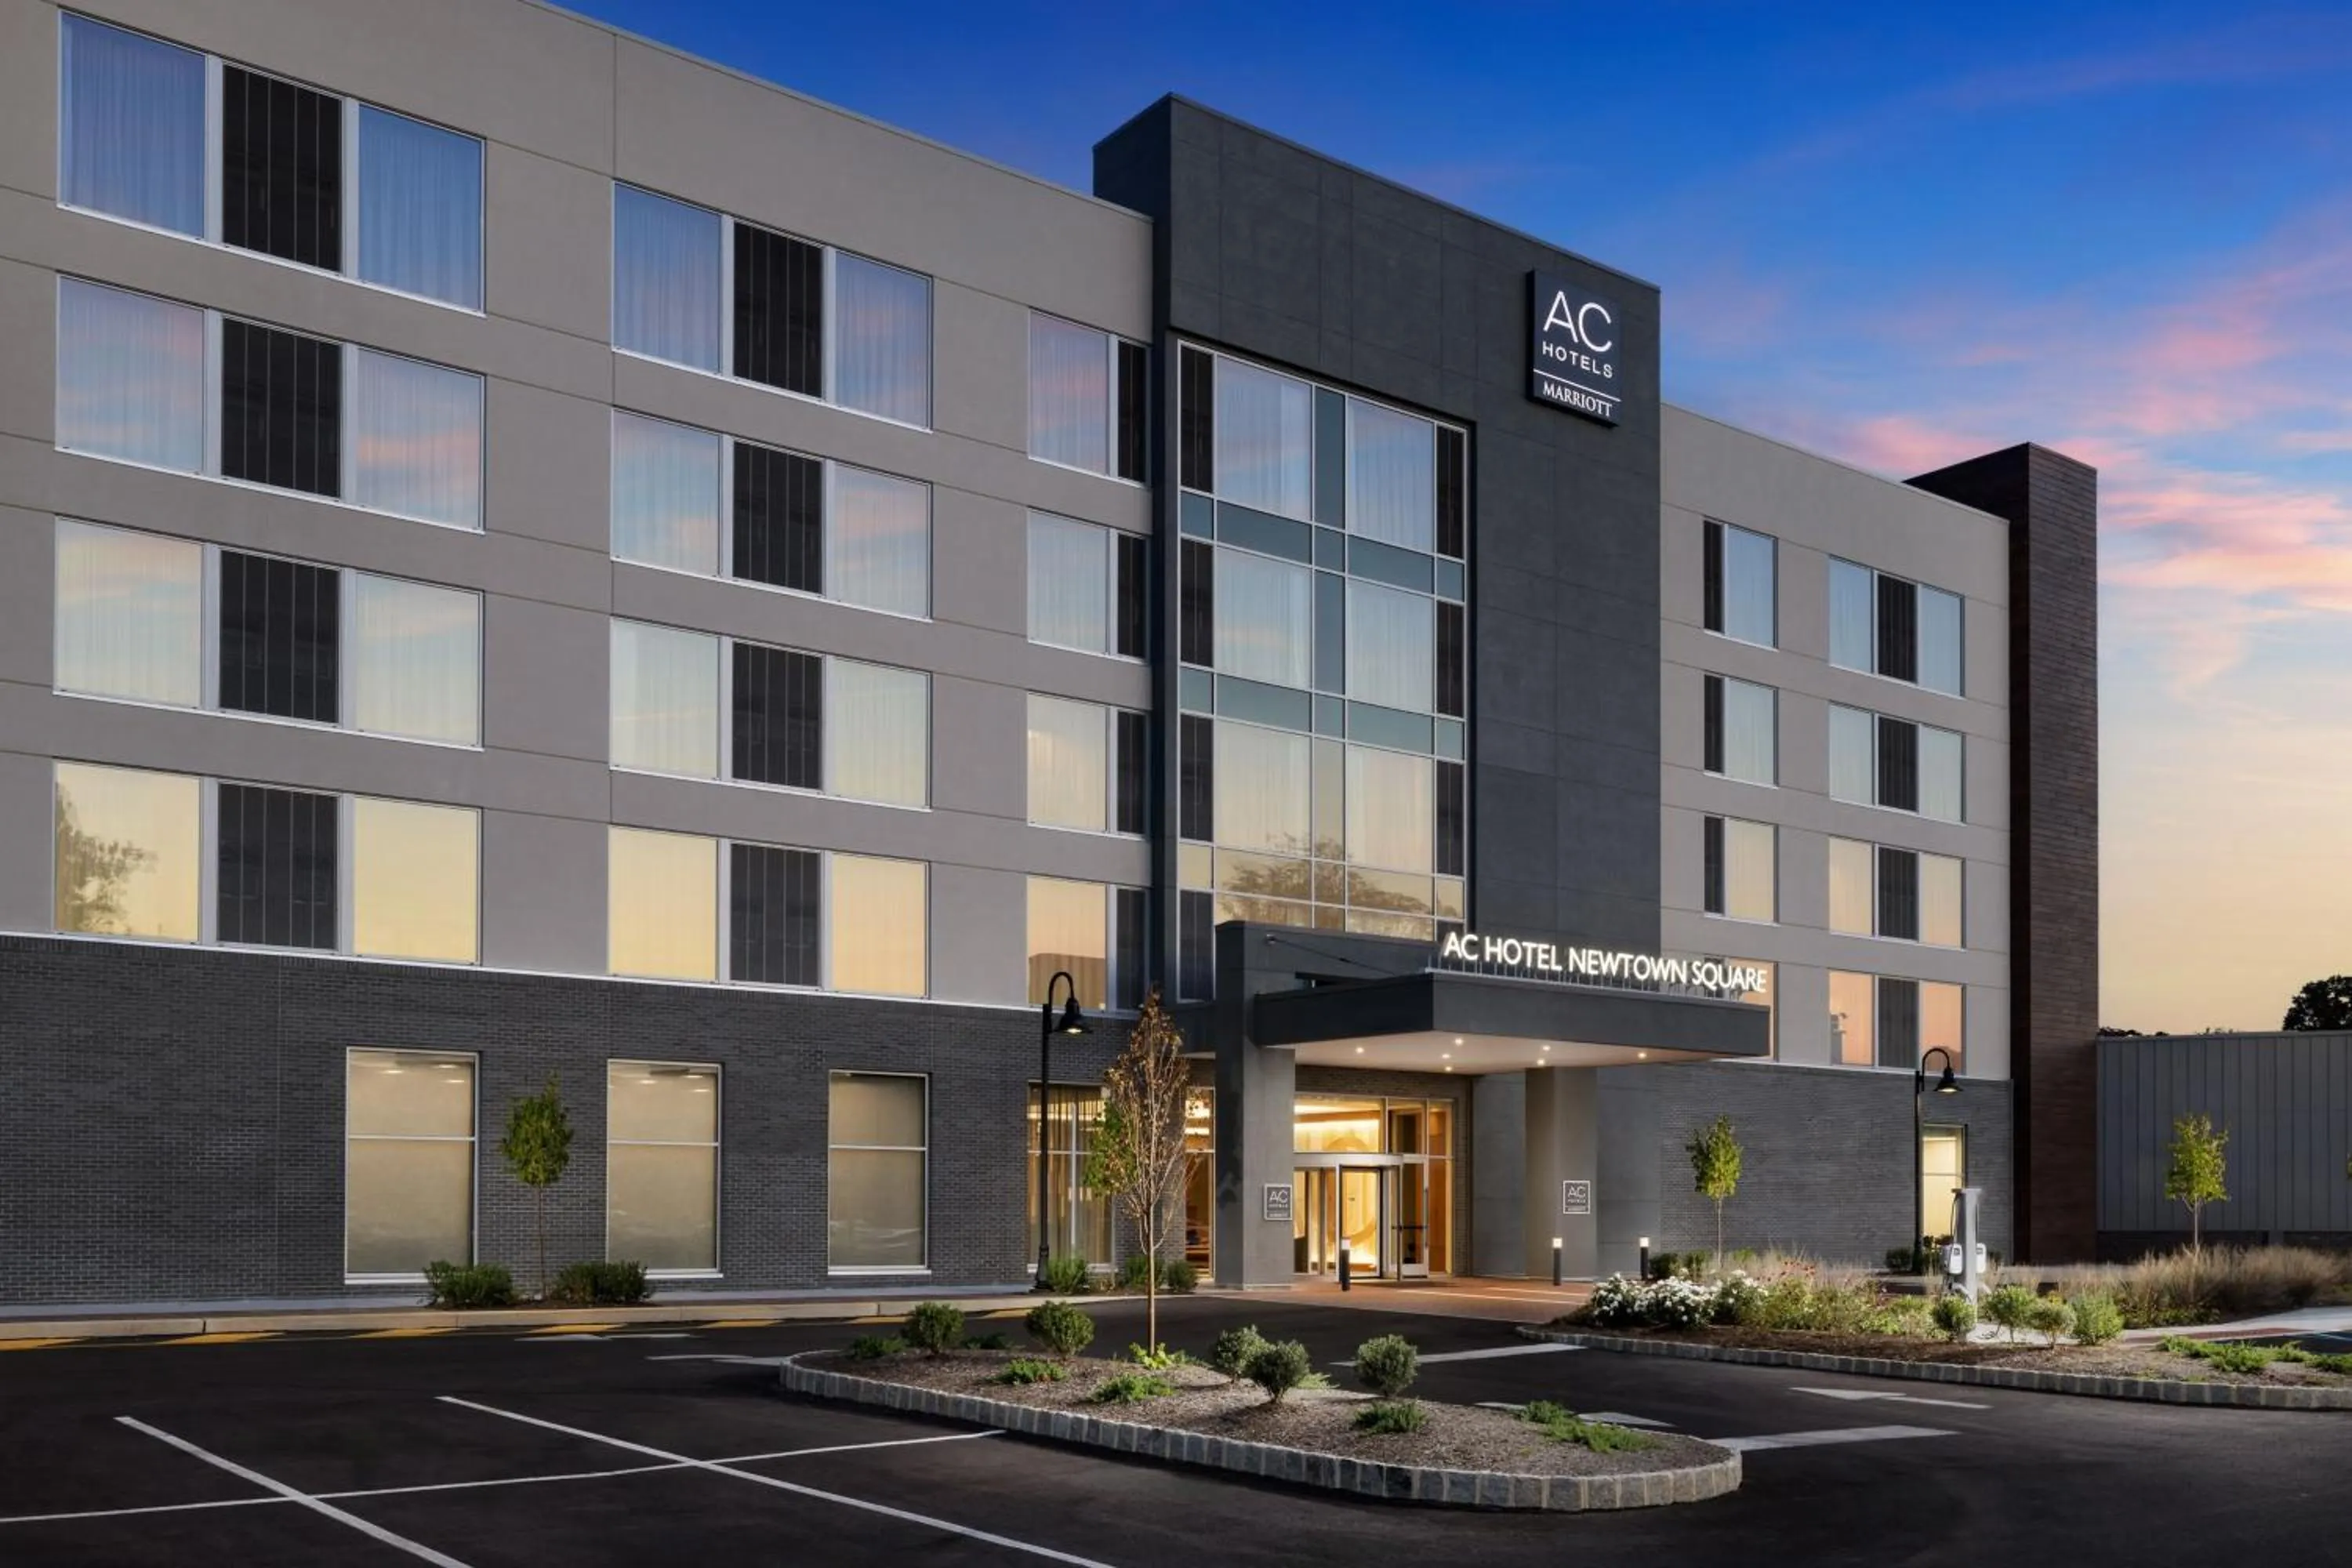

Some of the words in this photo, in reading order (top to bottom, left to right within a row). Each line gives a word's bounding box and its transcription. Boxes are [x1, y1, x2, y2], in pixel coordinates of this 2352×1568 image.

[1543, 290, 1612, 352] AC
[1542, 340, 1613, 379] HOTELS
[1542, 381, 1613, 417] MARRIOTT
[1443, 931, 1479, 960] AC
[1484, 936, 1563, 971] HOTEL
[1569, 946, 1687, 985] NEWTOWN
[1691, 960, 1768, 993] SQUARE
[1269, 1190, 1288, 1203] AC
[1567, 1185, 1586, 1199] AC
